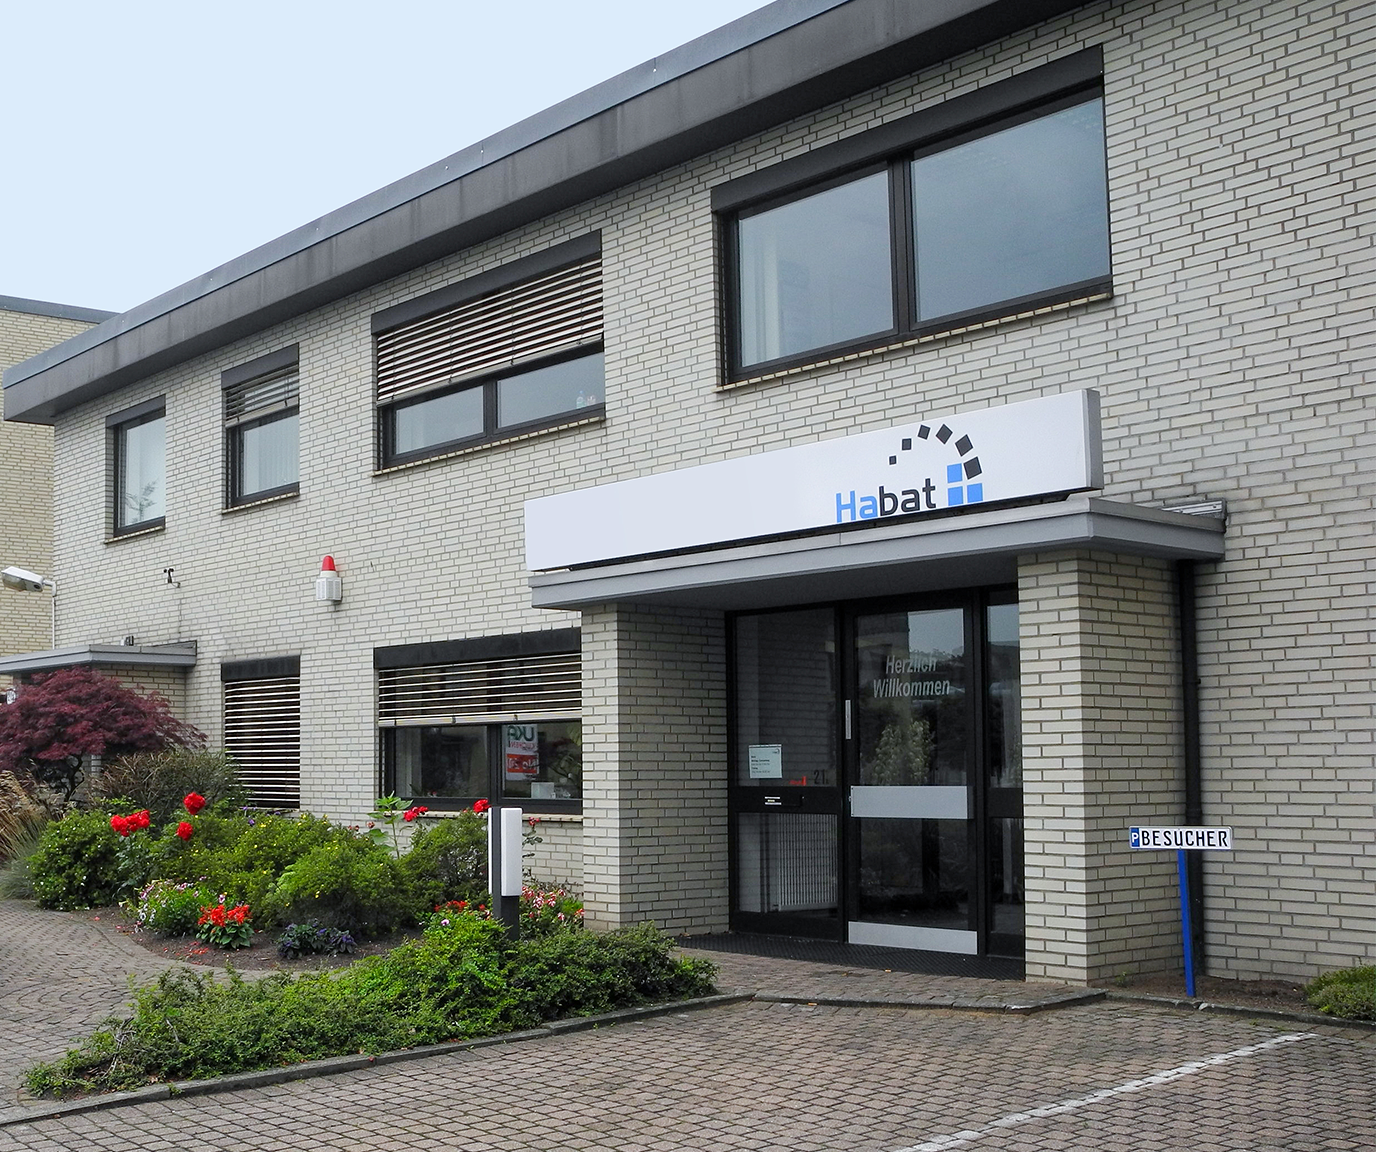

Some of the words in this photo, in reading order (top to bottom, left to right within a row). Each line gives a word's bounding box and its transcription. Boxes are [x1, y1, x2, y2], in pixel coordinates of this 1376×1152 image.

[836, 478, 936, 523] Habat
[886, 654, 937, 674] Herzlich
[873, 678, 951, 698] Willkommen
[1131, 832, 1139, 843] P
[1141, 830, 1228, 847] BESUCHER
